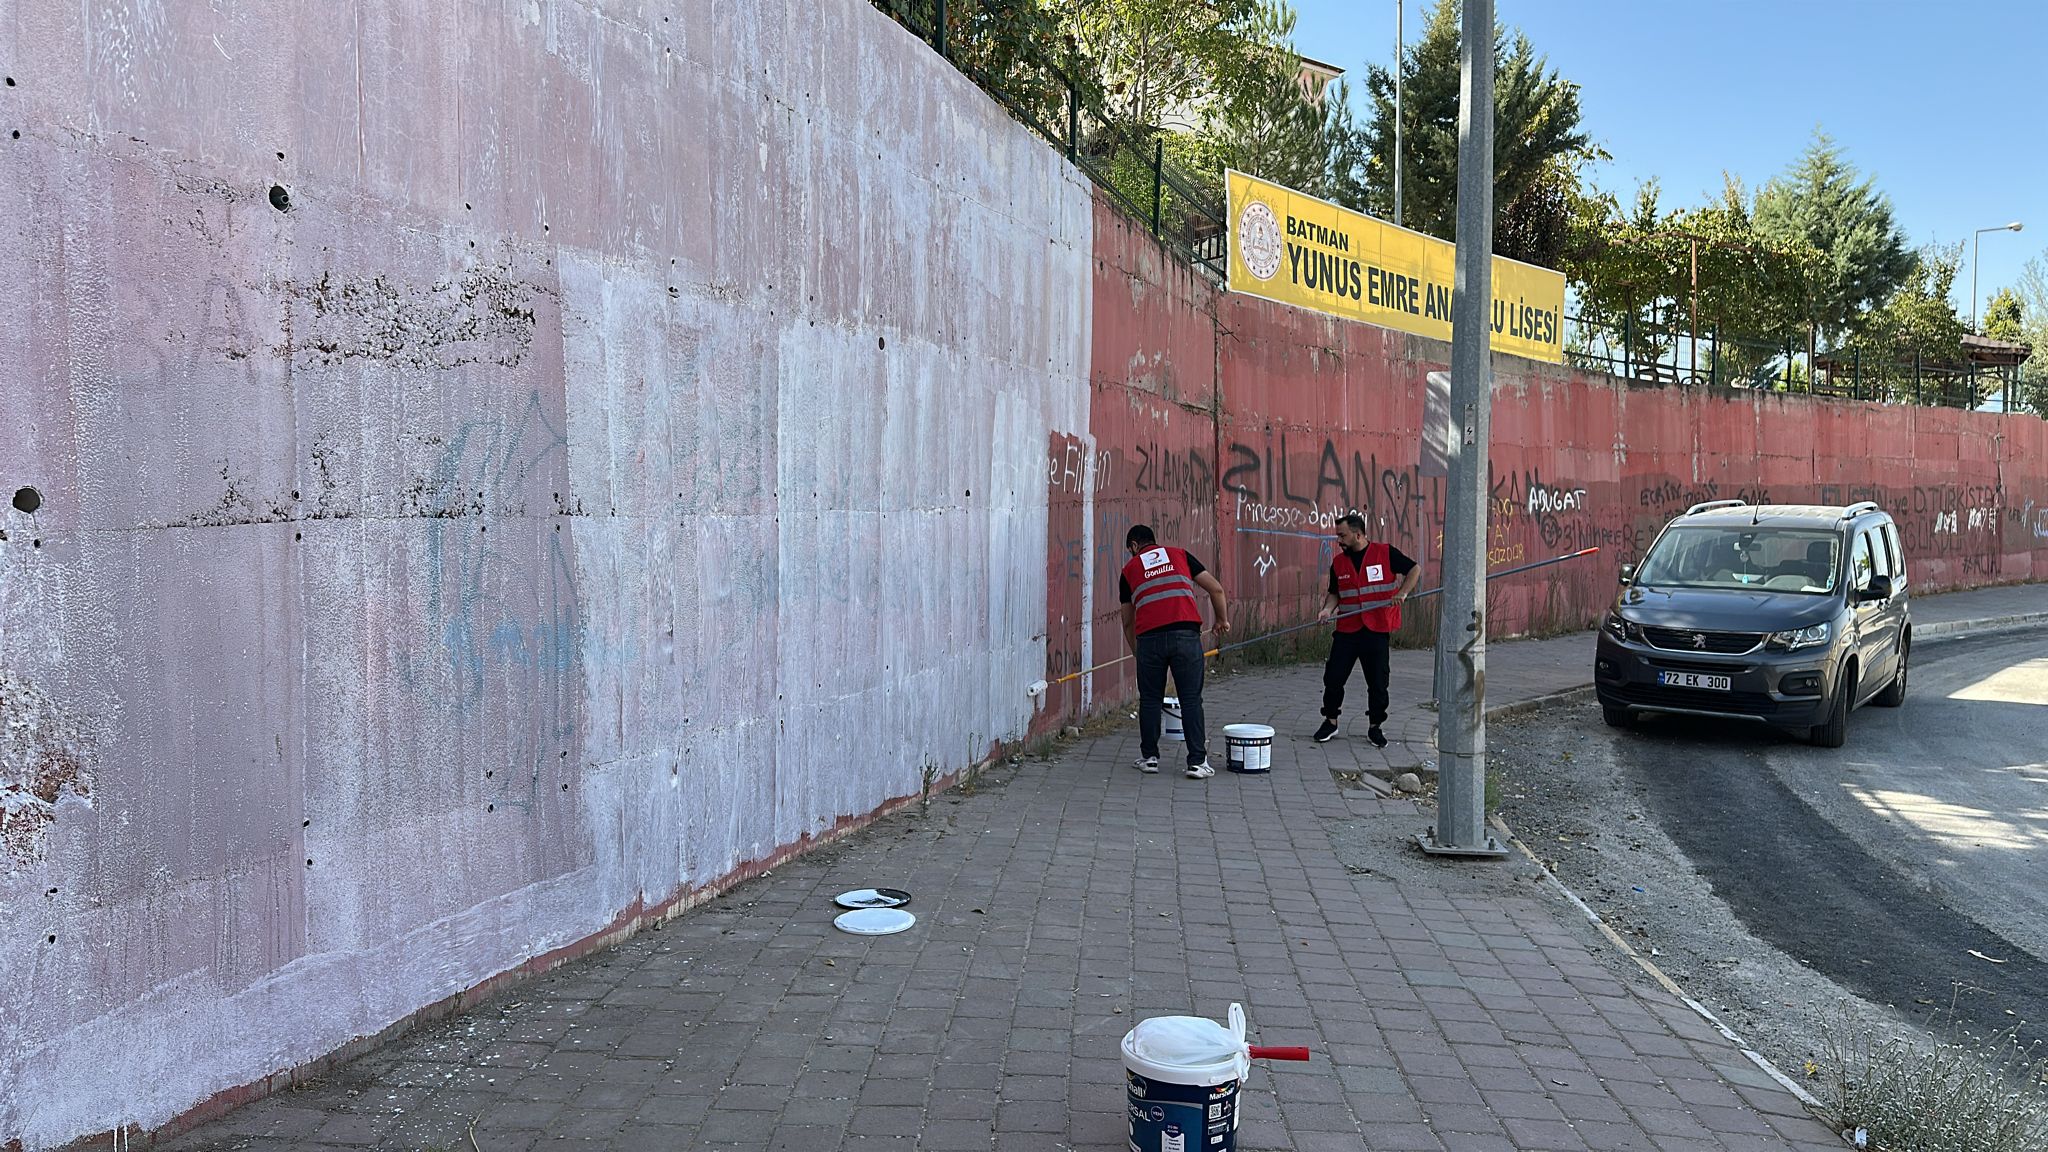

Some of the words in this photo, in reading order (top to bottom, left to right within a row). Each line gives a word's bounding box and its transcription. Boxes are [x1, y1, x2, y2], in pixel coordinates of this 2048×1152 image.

[1287, 215, 1348, 252] BATMAN
[1287, 242, 1361, 300] YUNUS
[1368, 266, 1419, 315] EMRE
[1510, 297, 1557, 344] LİSESİ
[1666, 673, 1679, 685] 72
[1686, 674, 1699, 686] EK
[1708, 676, 1728, 689] 300
